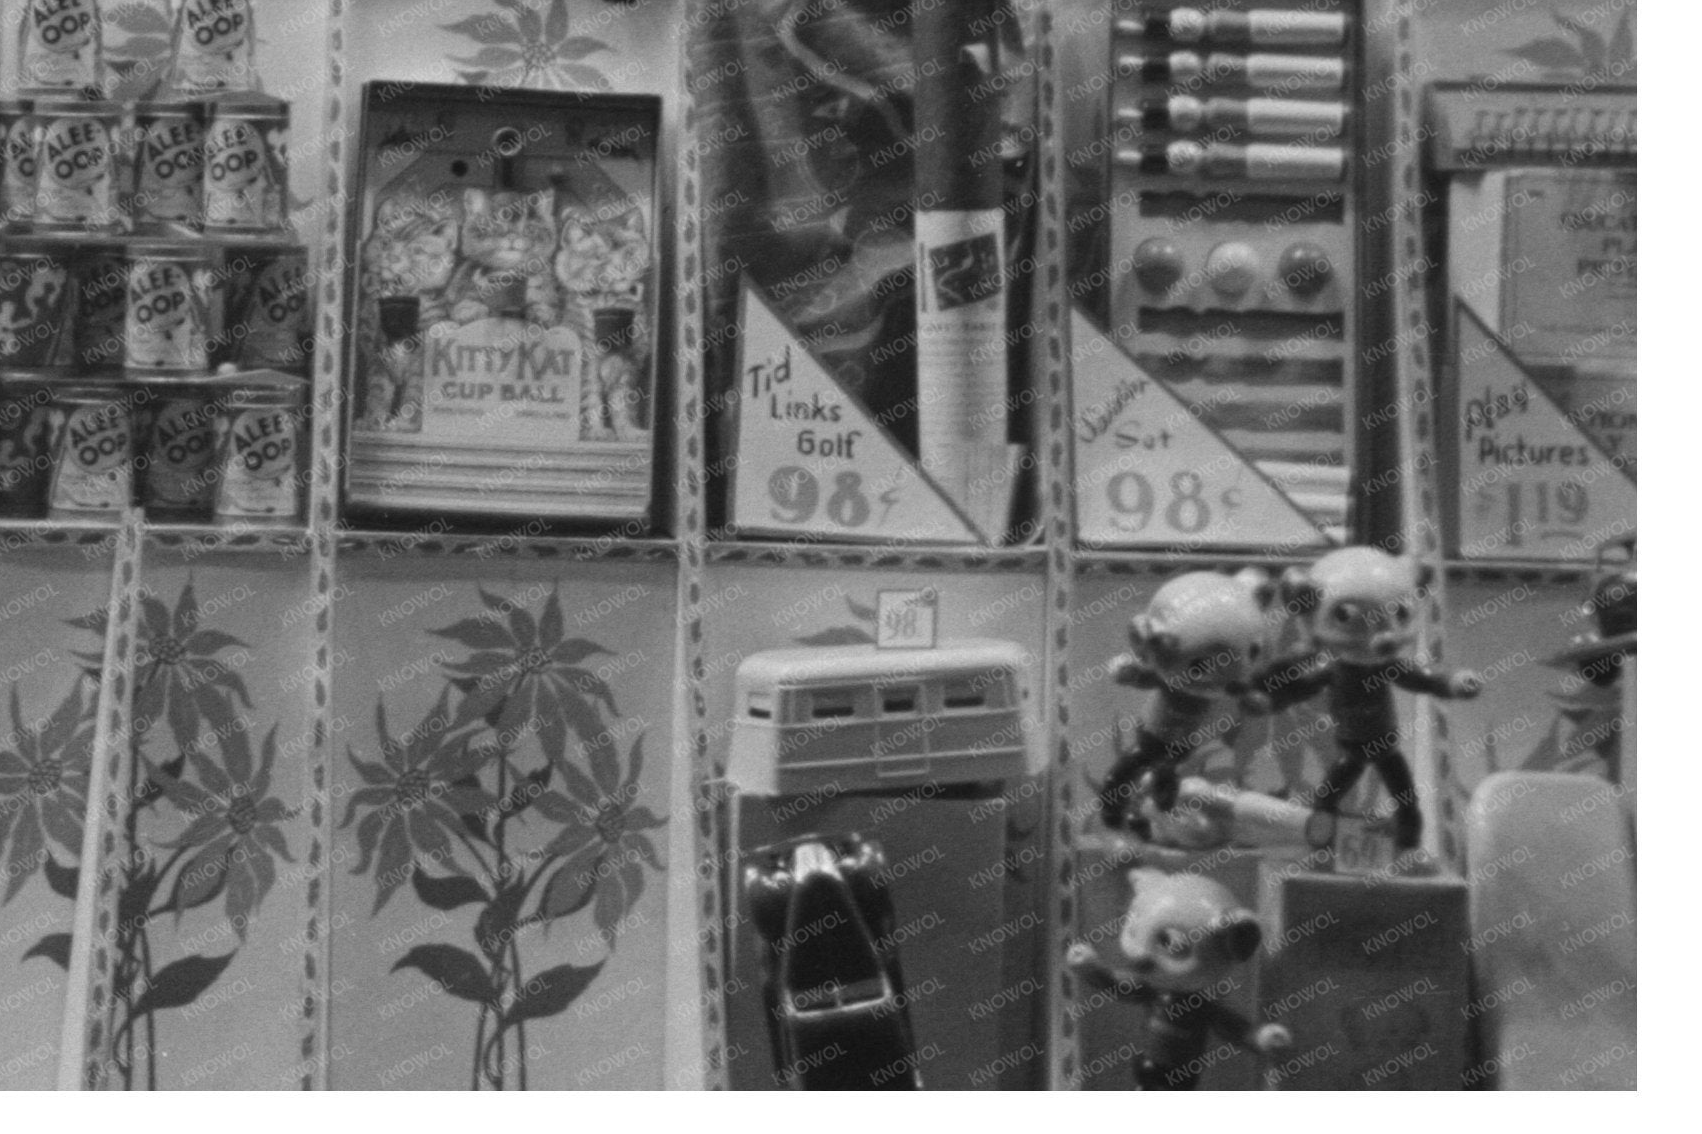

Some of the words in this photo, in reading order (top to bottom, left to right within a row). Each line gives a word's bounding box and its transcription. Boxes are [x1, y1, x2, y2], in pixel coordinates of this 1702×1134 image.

[42, 12, 91, 45] OOP
[195, 12, 244, 46] OOP
[47, 122, 97, 163] ALEE
[210, 149, 259, 182] OOP
[135, 290, 186, 324] OOP
[516, 340, 576, 381] KAT
[747, 345, 793, 398] Tid
[440, 381, 494, 400] CUP
[499, 382, 566, 403] BALL
[769, 389, 842, 424] Links
[233, 413, 284, 455] ALEE
[796, 430, 861, 460] Golf
[1478, 433, 1591, 467] Pictures
